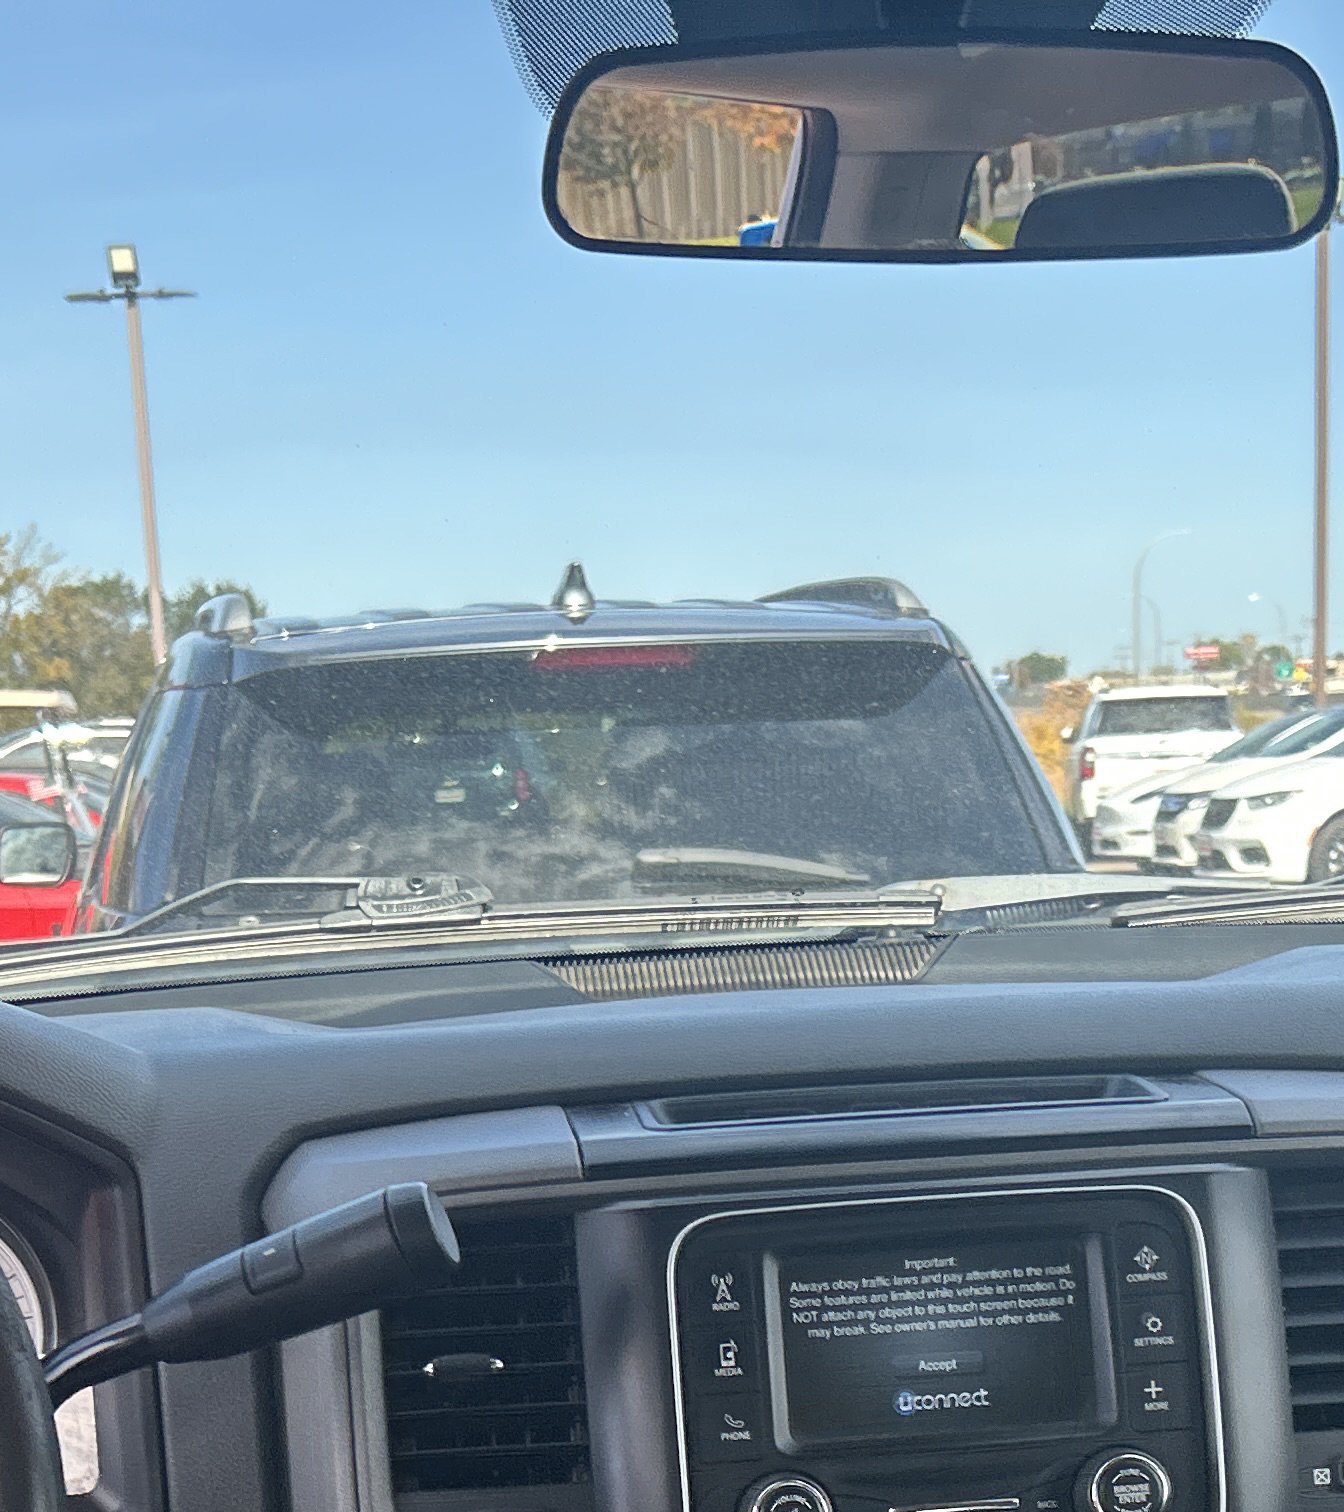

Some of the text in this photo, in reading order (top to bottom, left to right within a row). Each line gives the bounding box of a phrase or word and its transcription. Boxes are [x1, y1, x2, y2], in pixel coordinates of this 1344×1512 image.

[1126, 1271, 1169, 1283] COMPASS
[789, 1297, 821, 1308] Some
[824, 1295, 867, 1306] features
[1059, 1278, 1075, 1290] Do
[790, 1281, 831, 1293] Always
[832, 1280, 859, 1291] obey
[712, 1301, 741, 1312] RADIO
[792, 1310, 819, 1323] NOT
[821, 1310, 855, 1322] attach
[857, 1309, 876, 1320] any
[878, 1306, 913, 1319] object
[808, 1328, 831, 1340] may
[870, 1322, 893, 1334] See
[1134, 1336, 1175, 1347] SETTINGS
[714, 1367, 743, 1377] MEDIA
[918, 1359, 957, 1373] Accept
[896, 1388, 990, 1414] uconnect
[721, 1430, 752, 1441] PHONE
